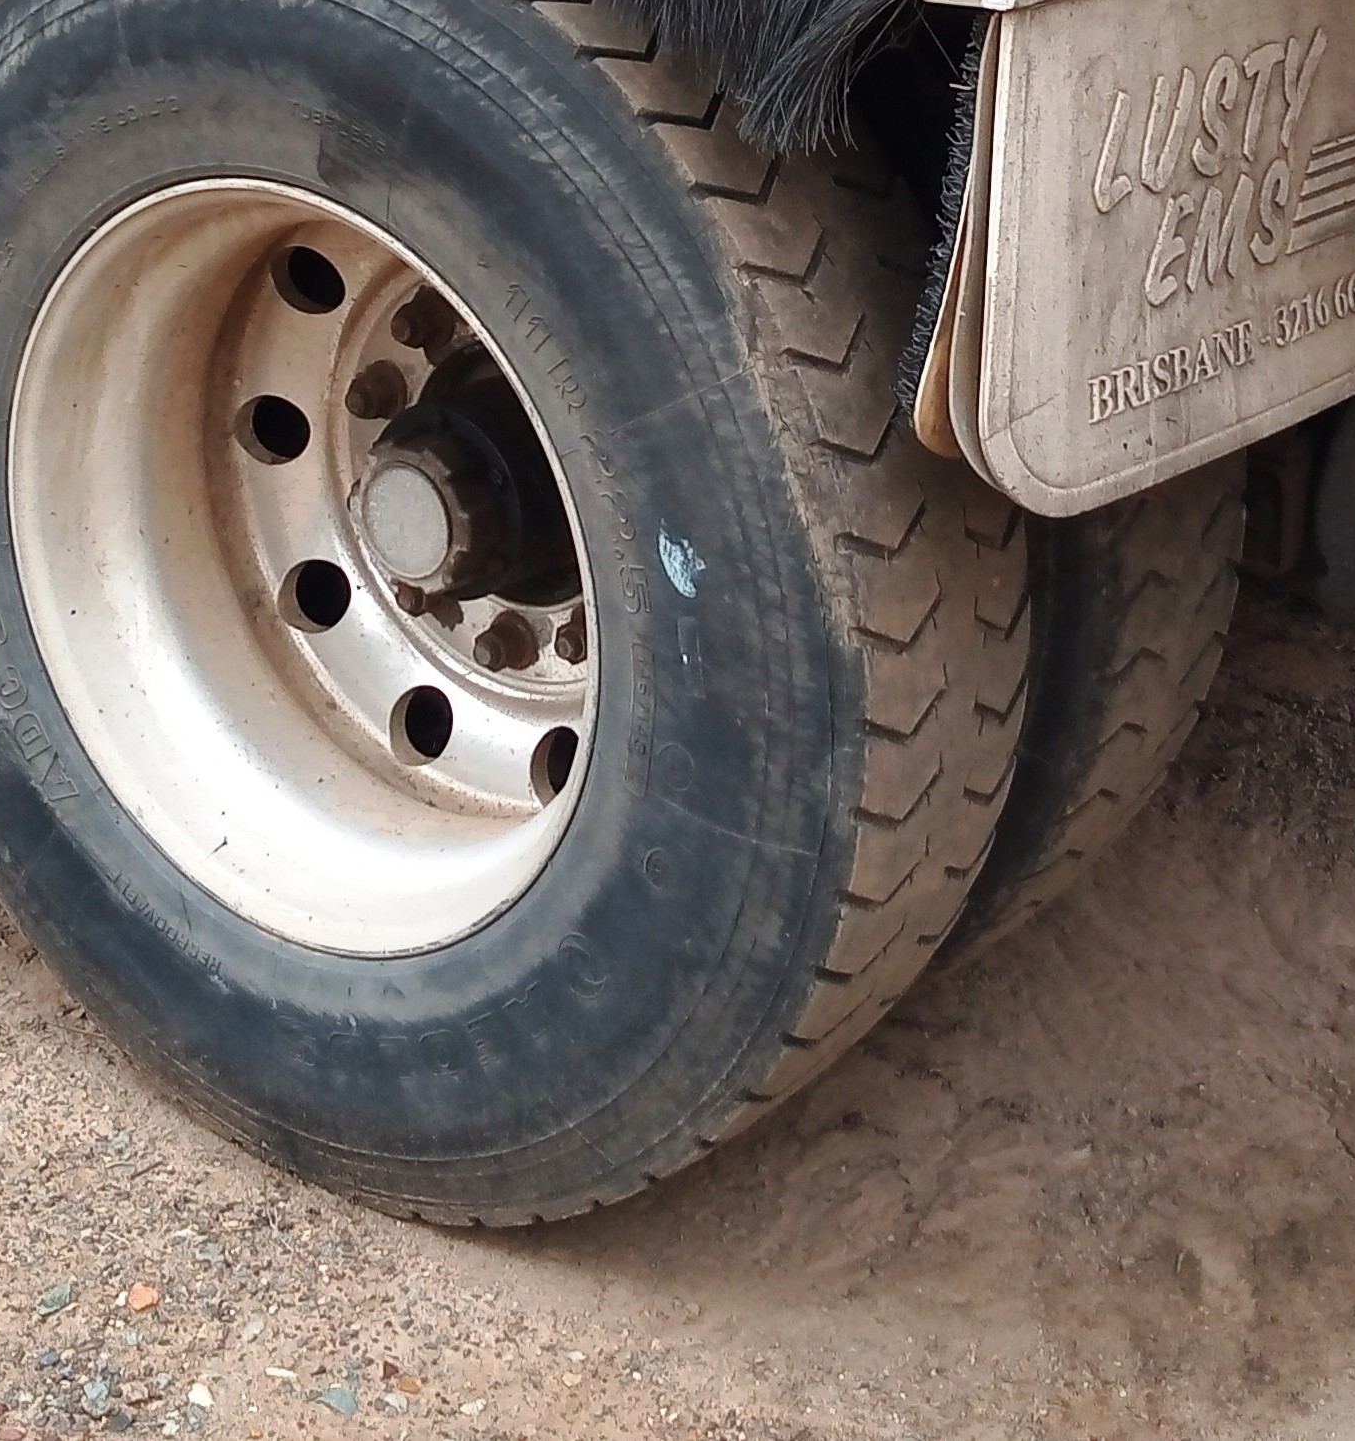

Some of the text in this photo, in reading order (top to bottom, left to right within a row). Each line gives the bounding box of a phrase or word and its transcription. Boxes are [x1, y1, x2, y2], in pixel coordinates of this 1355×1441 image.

[1092, 26, 1328, 214] LUSTY
[1145, 158, 1290, 308] EMS
[1088, 319, 1254, 425] BRISBANE
[1274, 289, 1331, 348] 3216
